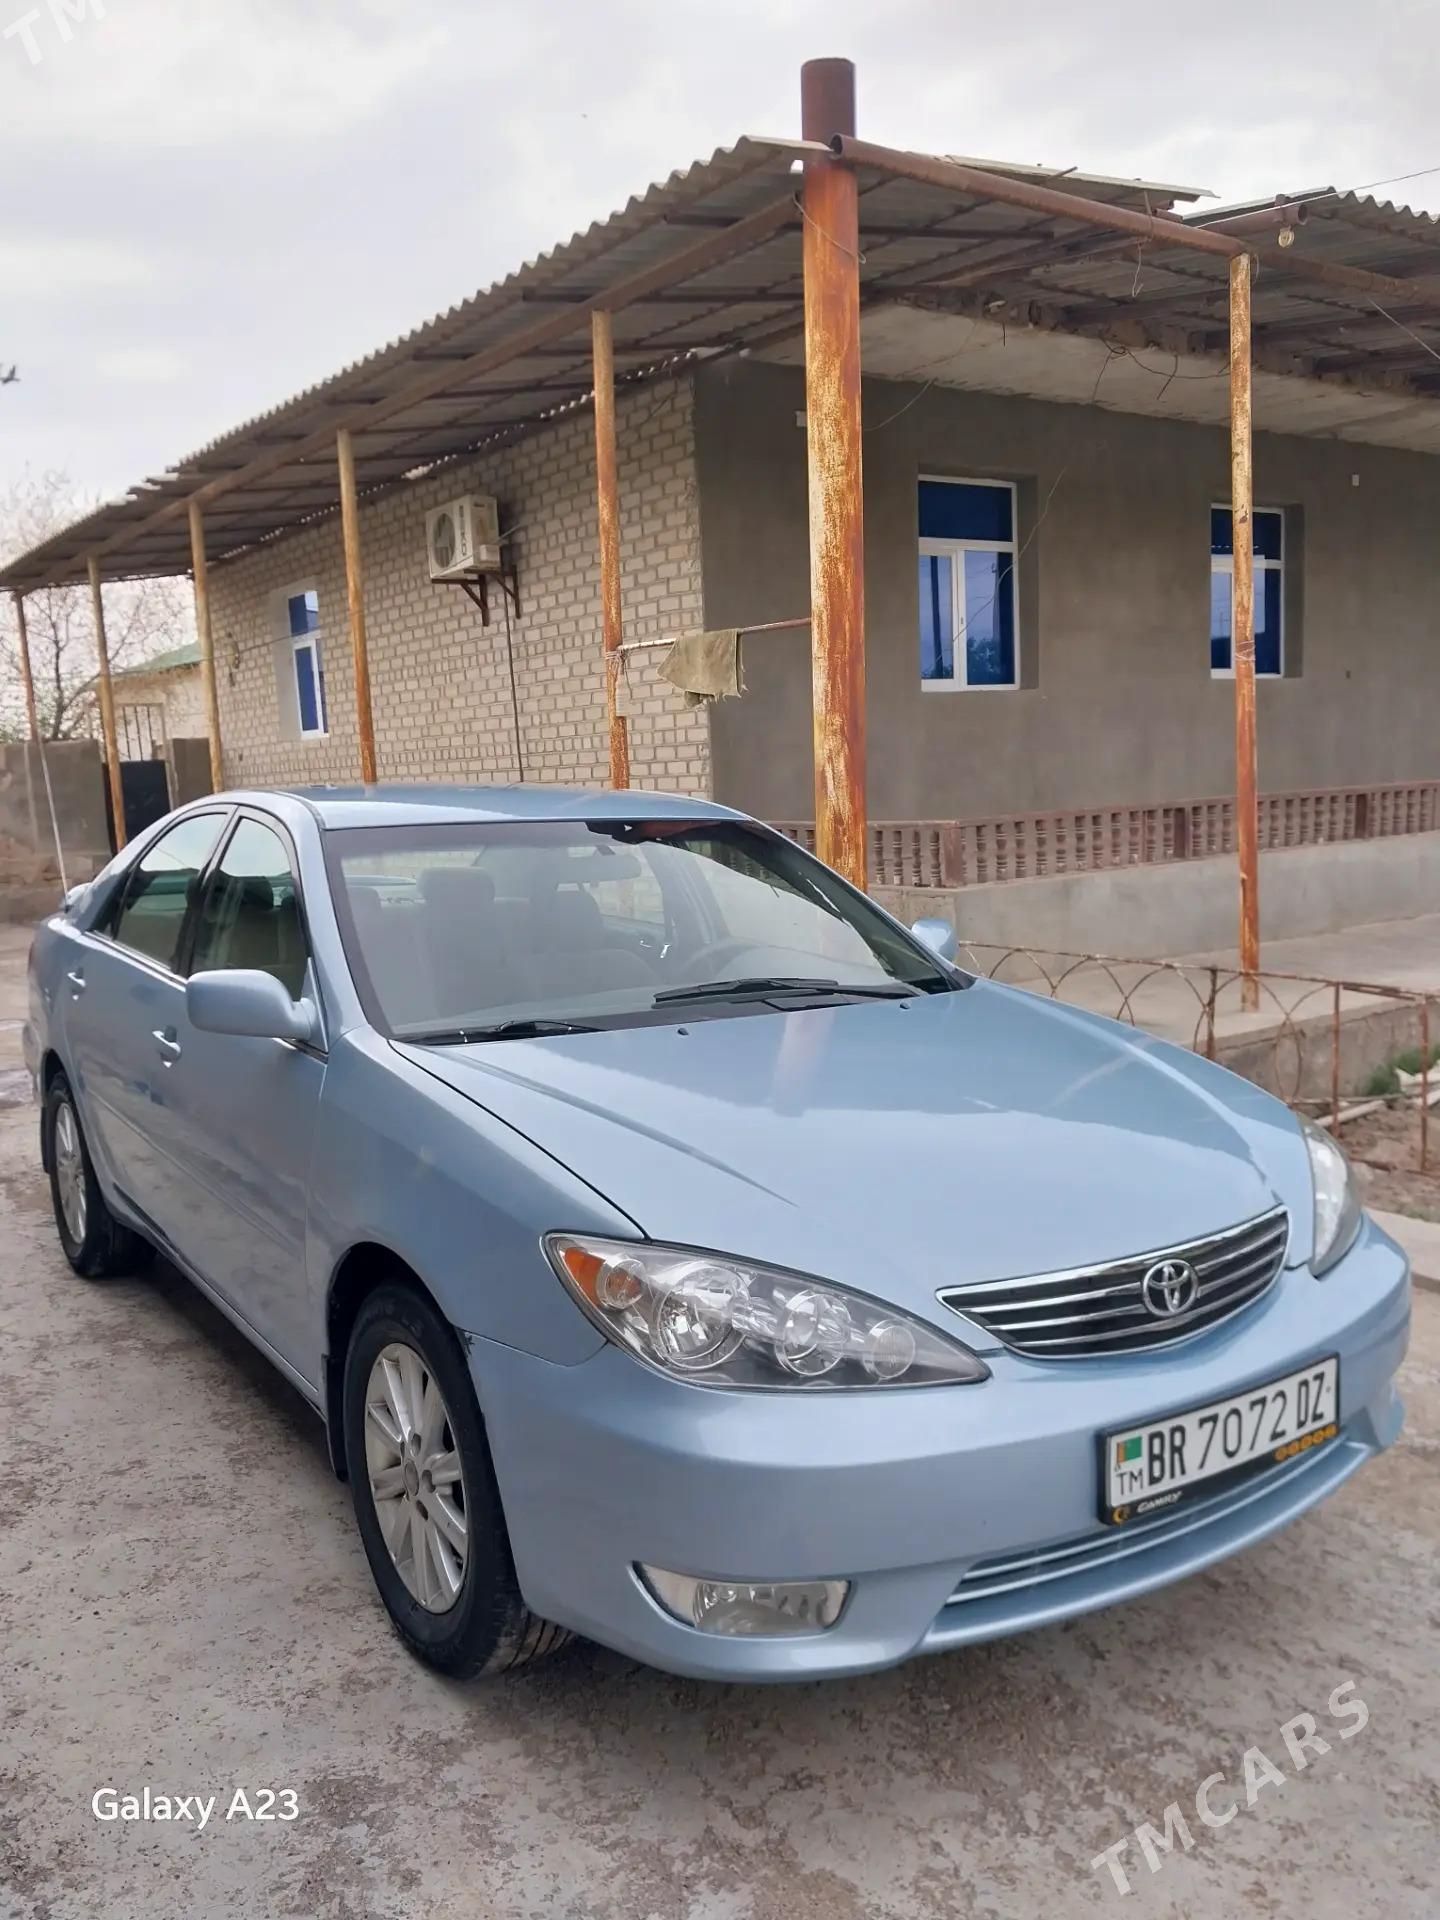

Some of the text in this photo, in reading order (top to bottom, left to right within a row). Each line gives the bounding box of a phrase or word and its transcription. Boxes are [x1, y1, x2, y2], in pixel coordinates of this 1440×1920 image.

[458, 504, 467, 556] KO
[1147, 1371, 1325, 1486] BR 7072 DZ
[1116, 1468, 1144, 1496] TM
